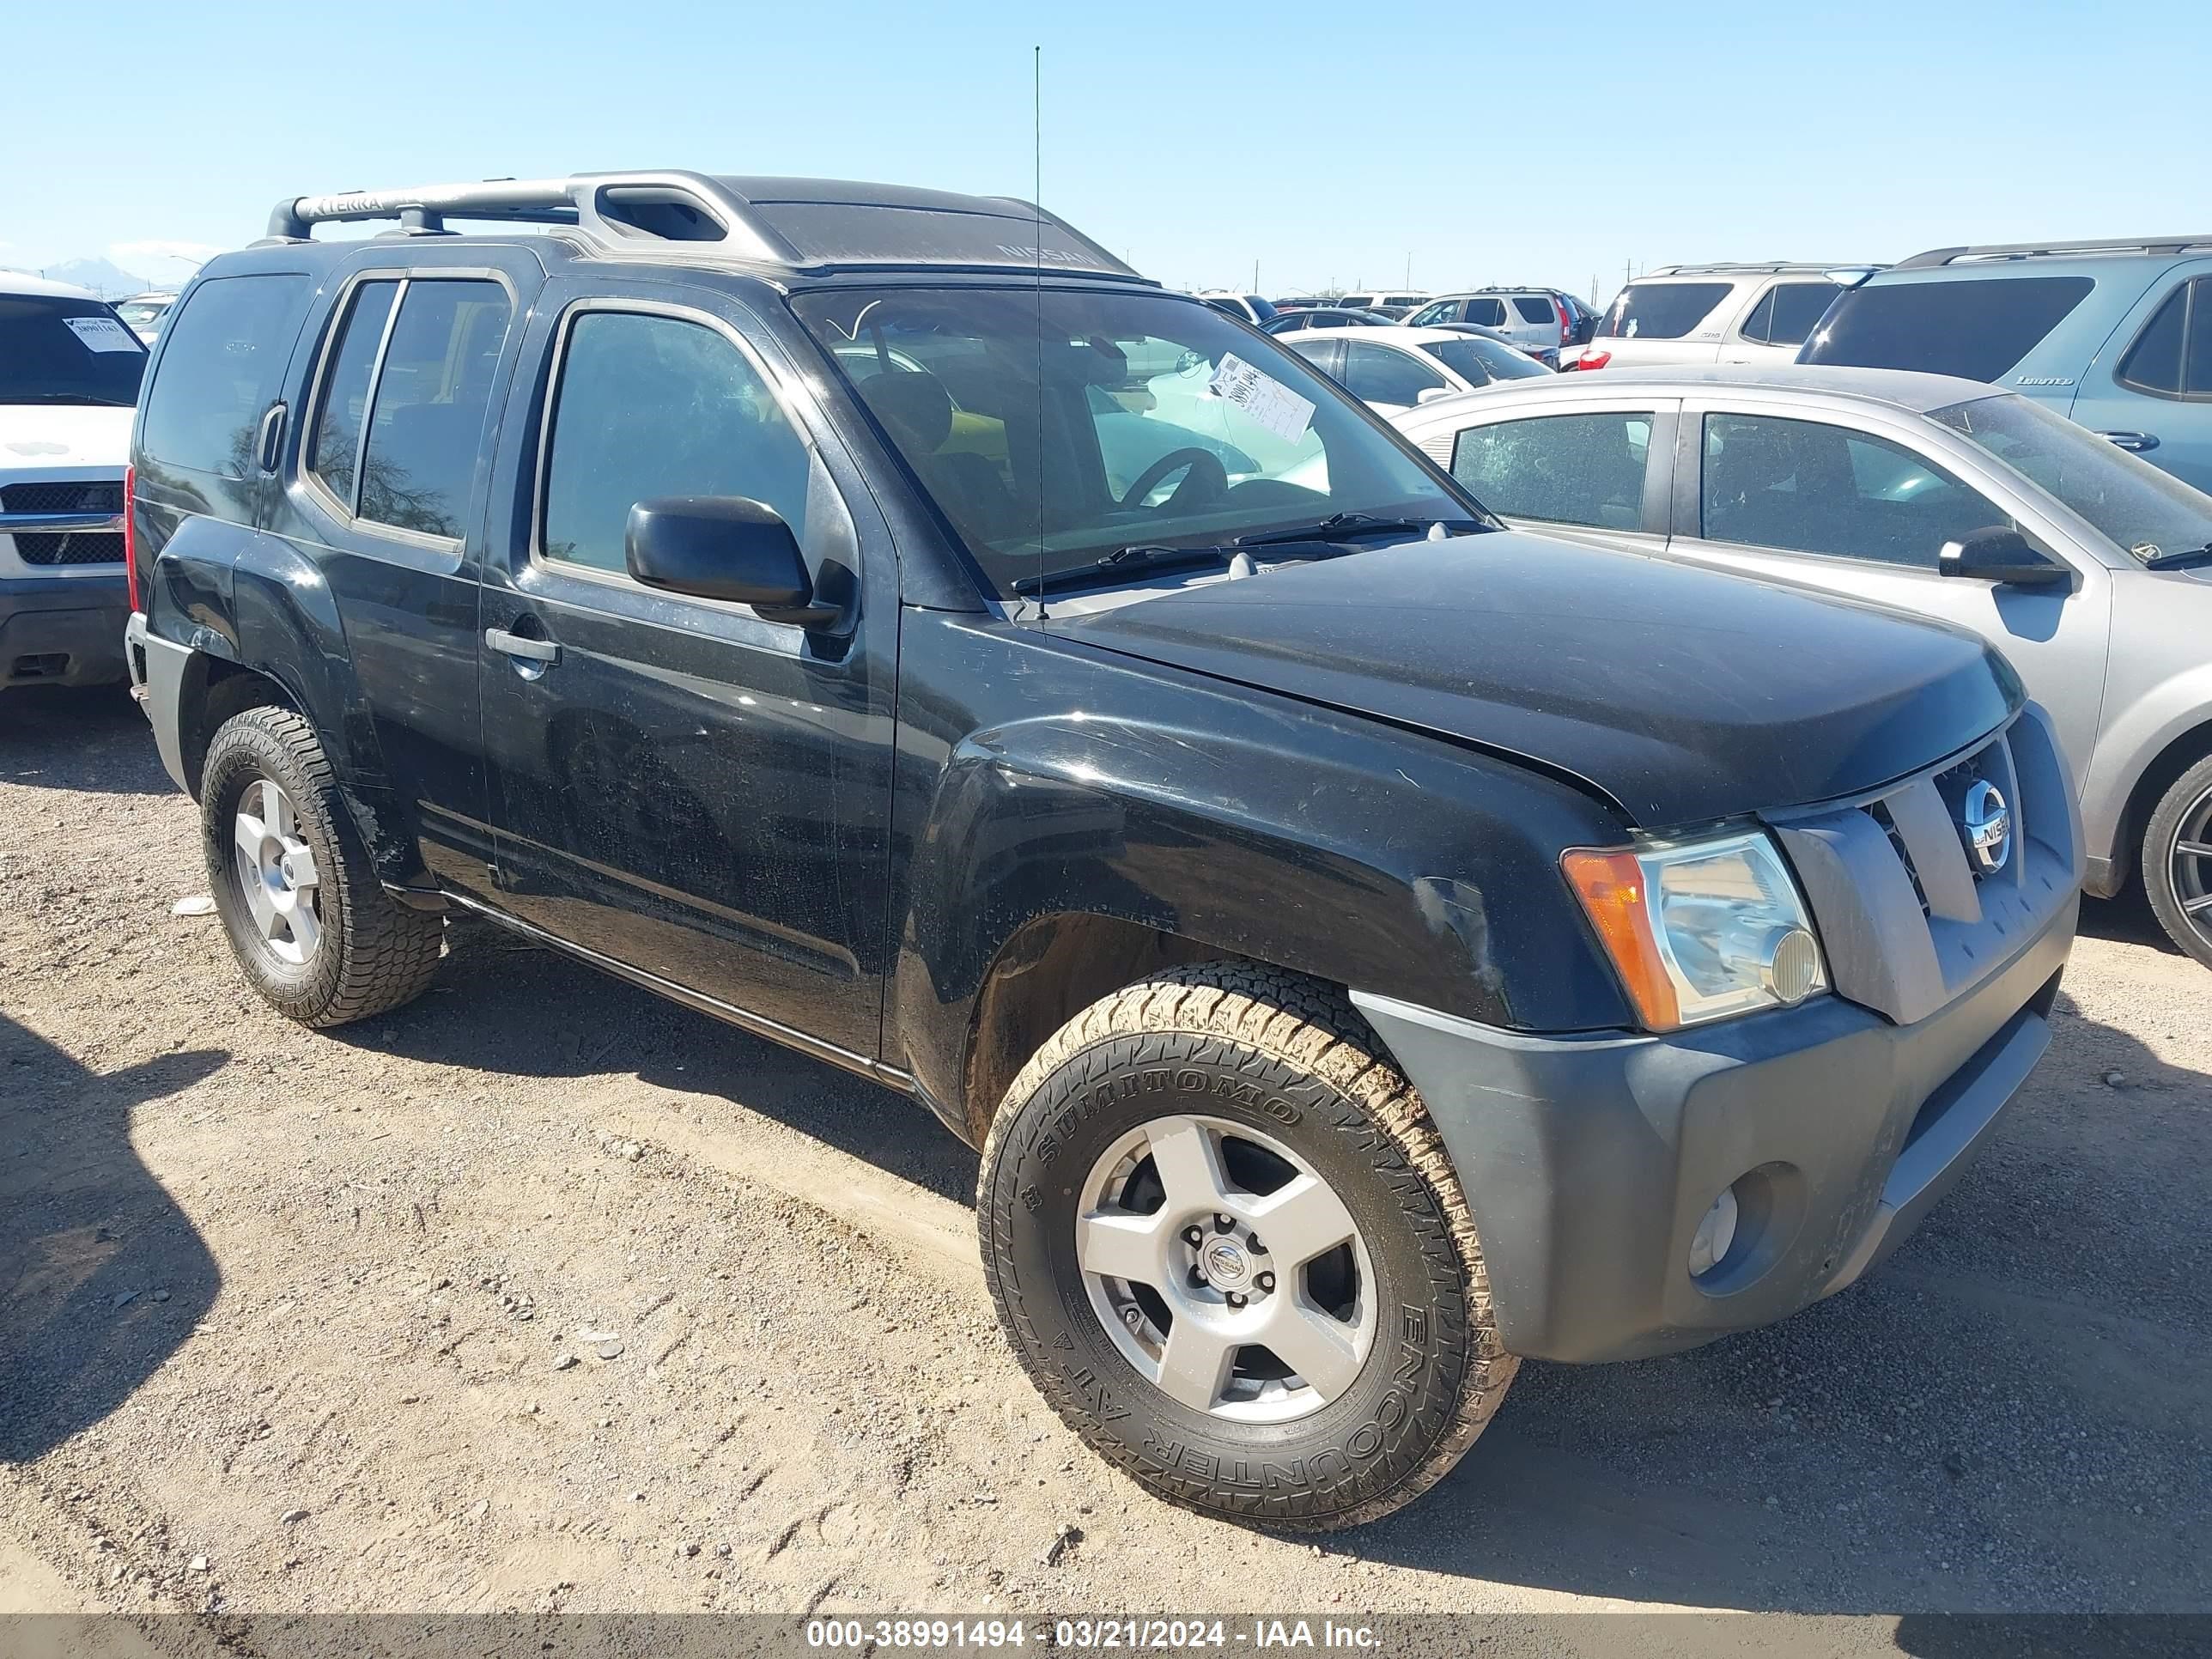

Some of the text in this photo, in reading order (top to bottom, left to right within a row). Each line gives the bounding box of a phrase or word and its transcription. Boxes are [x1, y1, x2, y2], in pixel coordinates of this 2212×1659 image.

[995, 244, 1099, 266] NISSAN
[1036, 1067, 1304, 1168] SUMITOMO
[1212, 1255, 1241, 1272] NISSAN
[1141, 1302, 1429, 1490] ENCOUNTER
